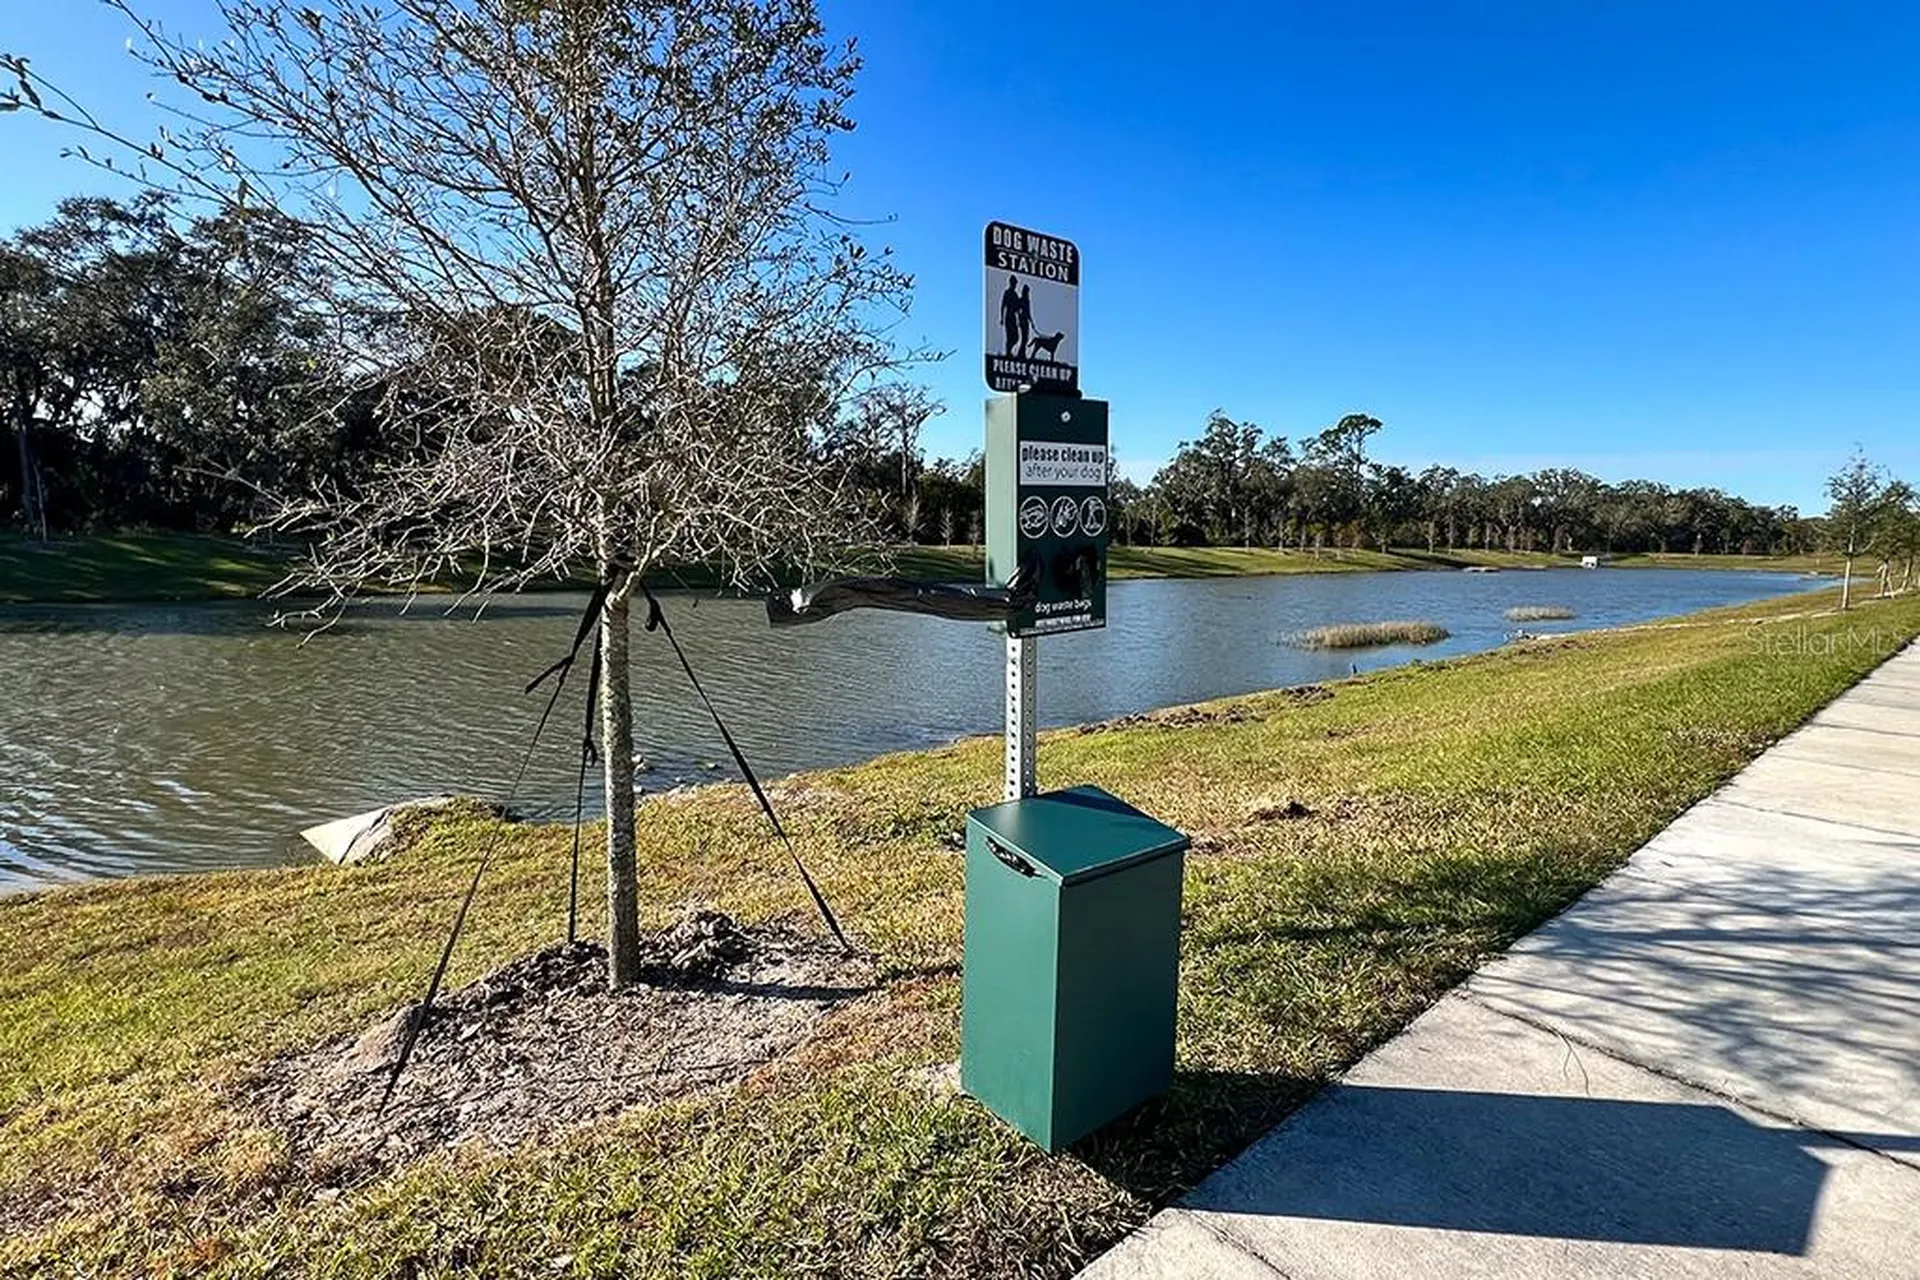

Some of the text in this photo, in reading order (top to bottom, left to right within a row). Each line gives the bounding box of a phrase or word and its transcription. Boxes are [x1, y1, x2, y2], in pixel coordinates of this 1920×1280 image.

[993, 226, 1073, 264] DOG WASTE
[998, 252, 1069, 282] STATION
[993, 359, 1072, 381] PLEASE CLEAN UP
[1022, 444, 1104, 465] please clean up
[1025, 462, 1101, 482] after your dog
[1034, 601, 1050, 615] dog
